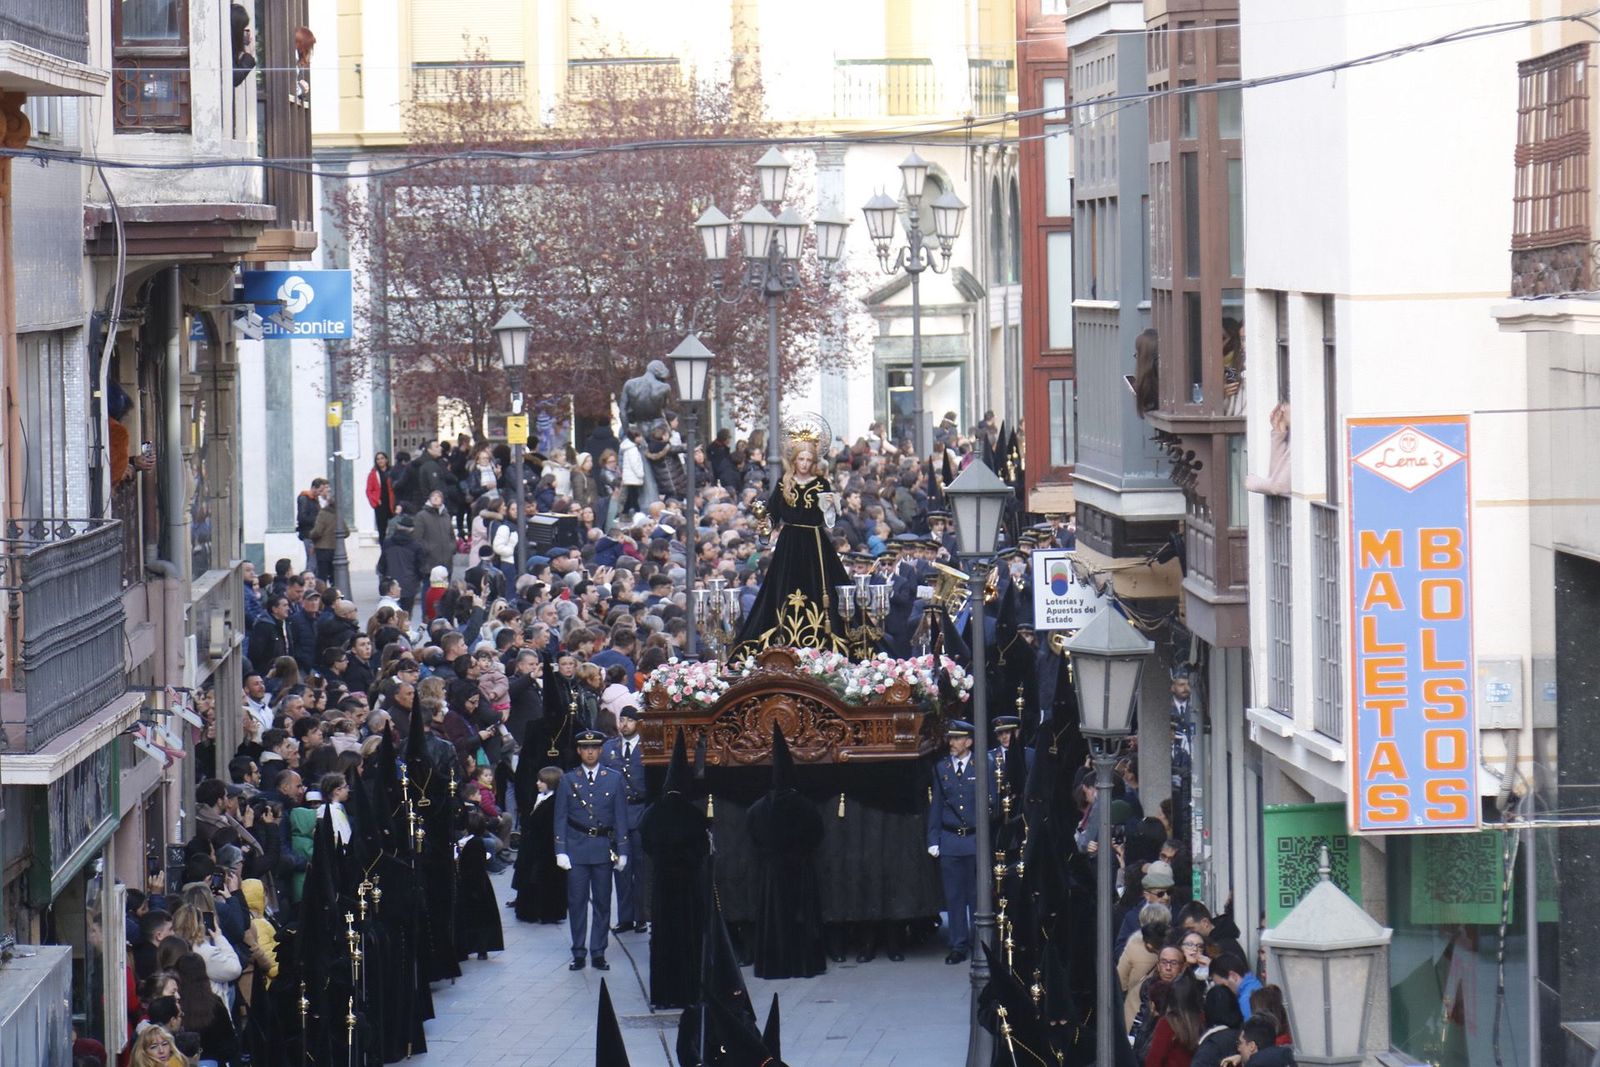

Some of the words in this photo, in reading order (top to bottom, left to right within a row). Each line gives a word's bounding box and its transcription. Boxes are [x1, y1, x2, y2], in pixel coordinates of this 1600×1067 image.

[262, 319, 345, 334] asonite
[1375, 448, 1428, 468] Lema
[1433, 450, 1444, 469] 3
[1046, 607, 1082, 615] Apuestas
[1359, 528, 1410, 823] MALETAS
[1418, 527, 1469, 821] BOLSOS
